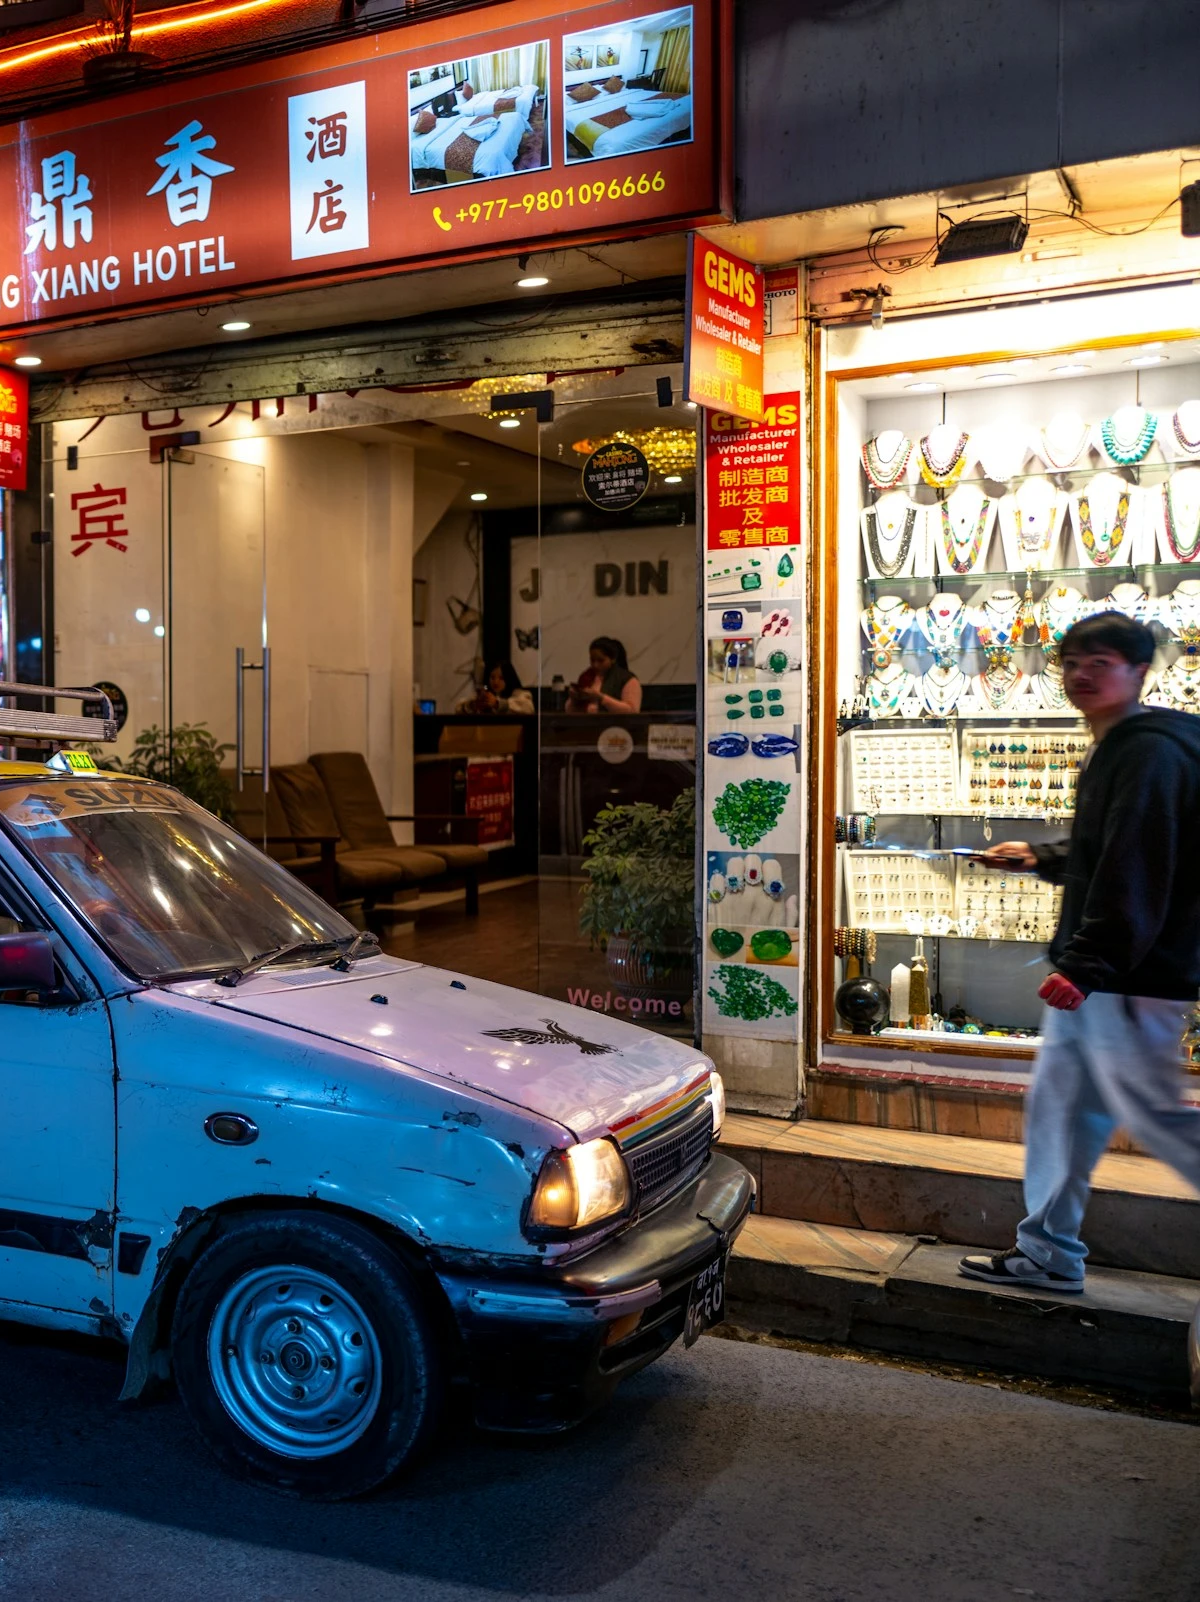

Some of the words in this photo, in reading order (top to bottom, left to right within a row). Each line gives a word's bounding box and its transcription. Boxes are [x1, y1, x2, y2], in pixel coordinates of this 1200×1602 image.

[304, 110, 348, 236] 酒店
[455, 170, 666, 225] +977-9801096666
[31, 255, 120, 304] XIANG
[133, 235, 236, 286] HOTEL
[704, 250, 756, 308] GEMS
[708, 298, 751, 330] Manufacturer
[695, 315, 732, 343] Wholesaler
[732, 330, 737, 345] &
[738, 332, 761, 355] Retailer
[710, 428, 797, 443] Manufacturer
[717, 440, 789, 455] Wholesaler
[722, 457, 730, 466] &
[734, 453, 784, 465] Retailer
[718, 466, 789, 487] 制造商
[719, 486, 789, 508] 批发商
[70, 483, 129, 558] 宾
[742, 507, 764, 526] 及
[719, 526, 789, 547] 零售商
[595, 560, 669, 597] DIN
[65, 753, 96, 769] TAXI
[567, 987, 681, 1016] Welcome
